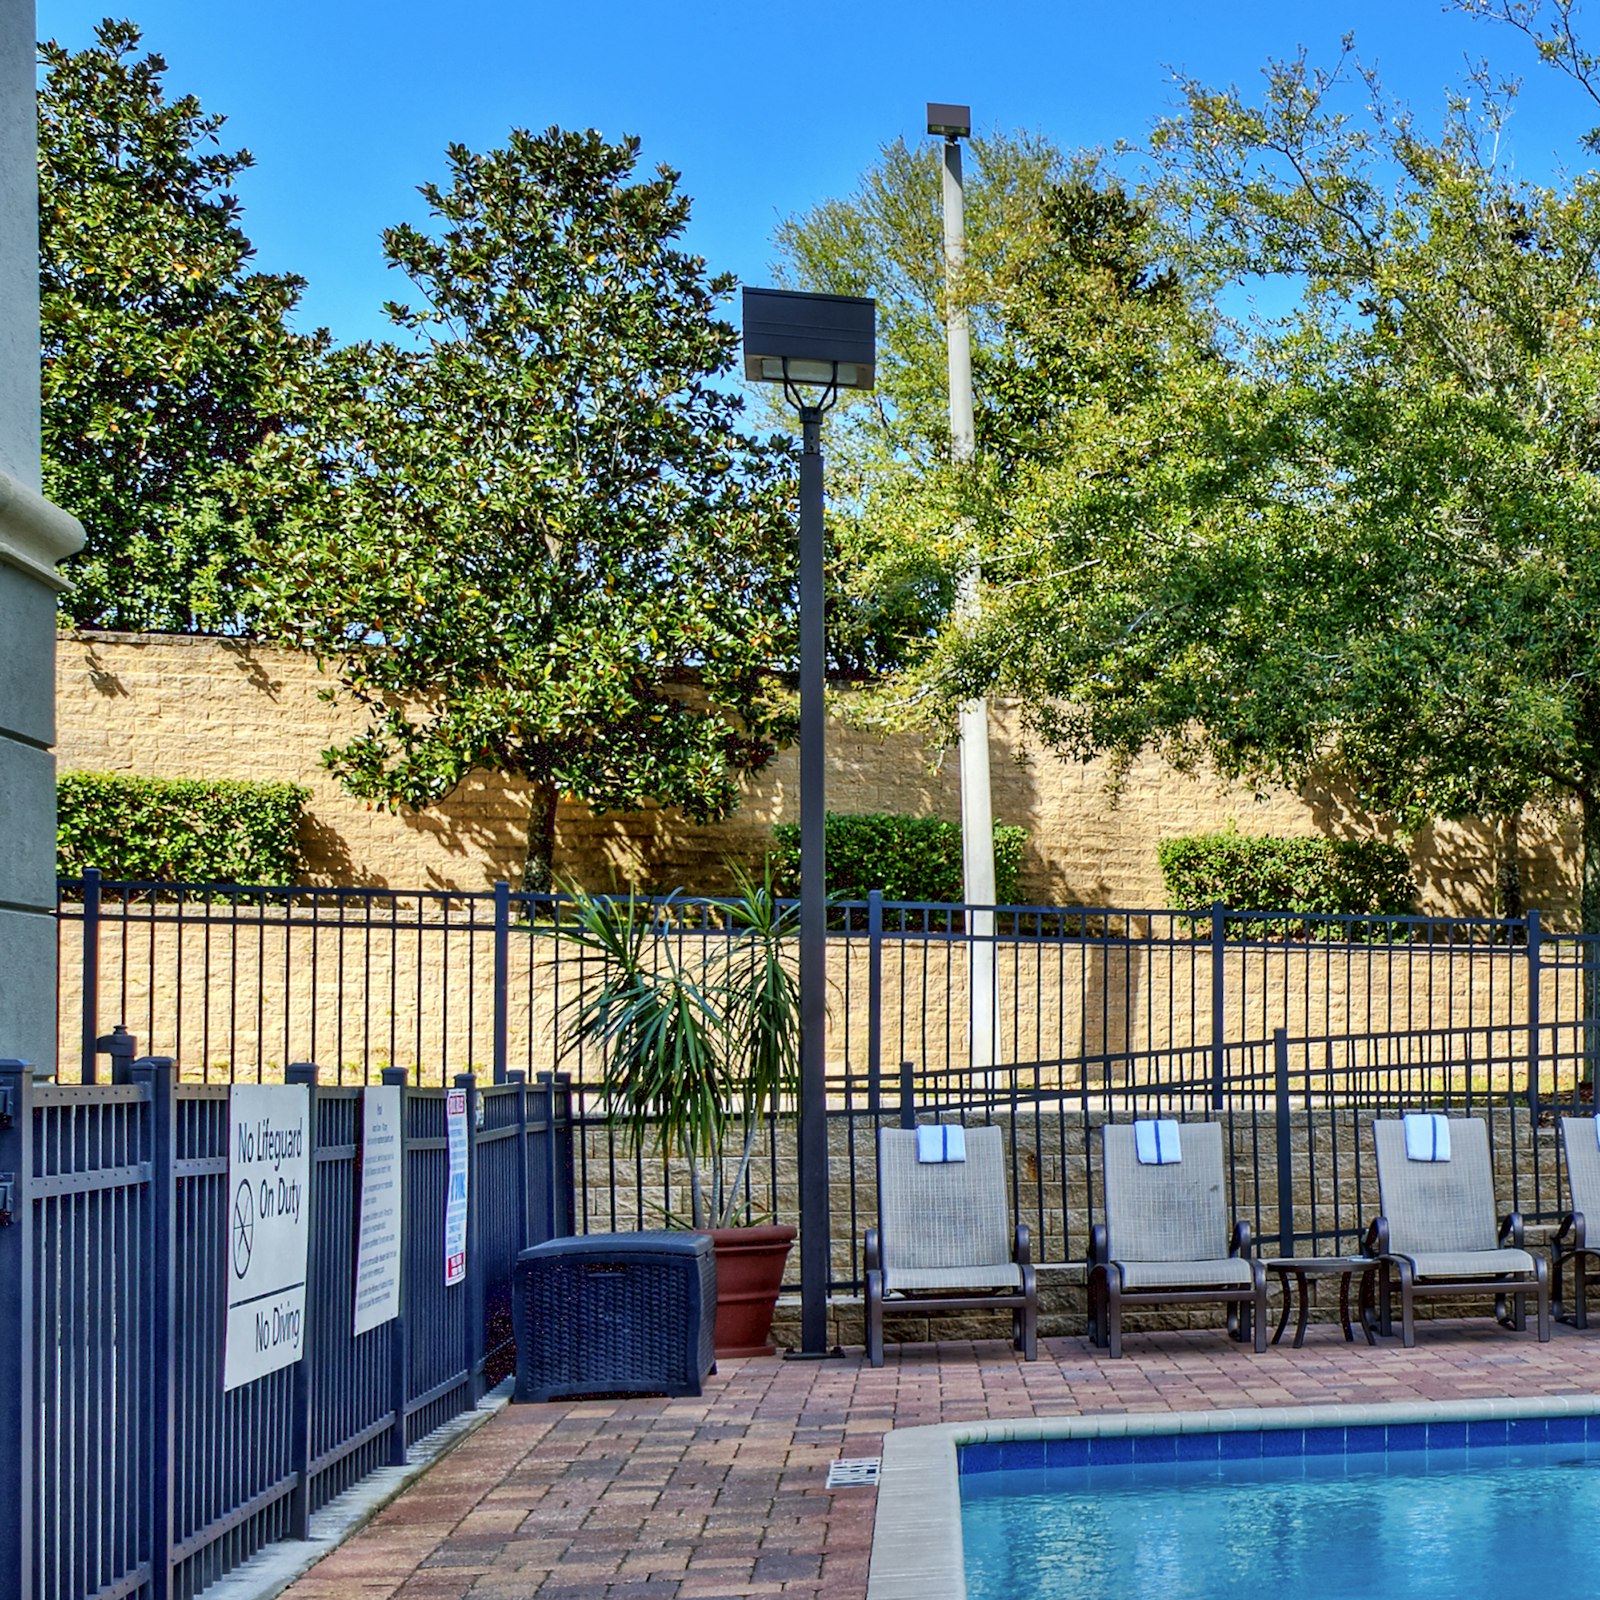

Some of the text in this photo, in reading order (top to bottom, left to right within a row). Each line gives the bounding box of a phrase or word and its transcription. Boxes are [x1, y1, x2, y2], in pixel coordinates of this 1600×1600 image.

[238, 1118, 303, 1172] No Lifeguard
[259, 1176, 302, 1225] On Duty
[255, 1301, 300, 1353] No Diving
